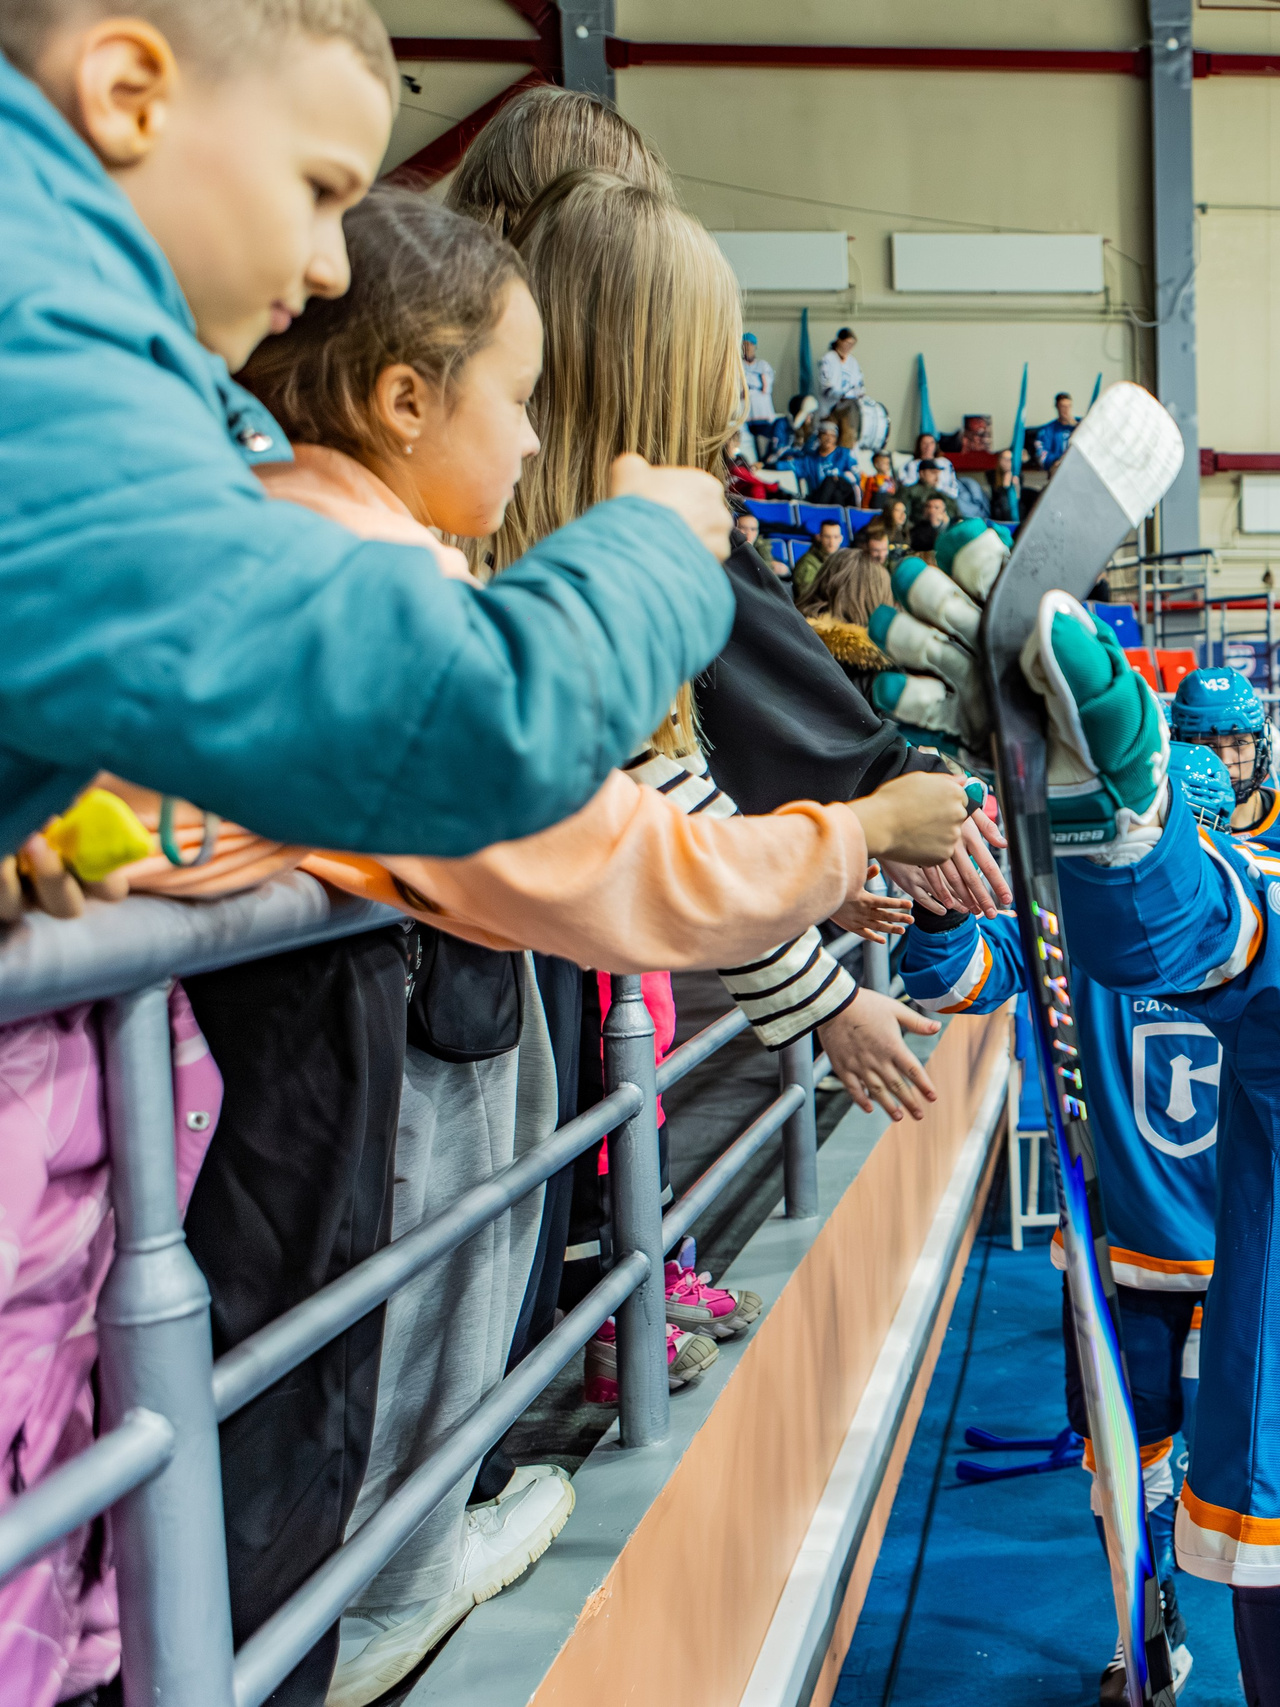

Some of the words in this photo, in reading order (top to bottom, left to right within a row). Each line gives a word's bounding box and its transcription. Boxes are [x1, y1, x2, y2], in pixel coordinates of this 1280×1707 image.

[1205, 677, 1230, 692] 43
[1031, 900, 1088, 1121] FLYLITE
[1133, 999, 1179, 1013] САХ
